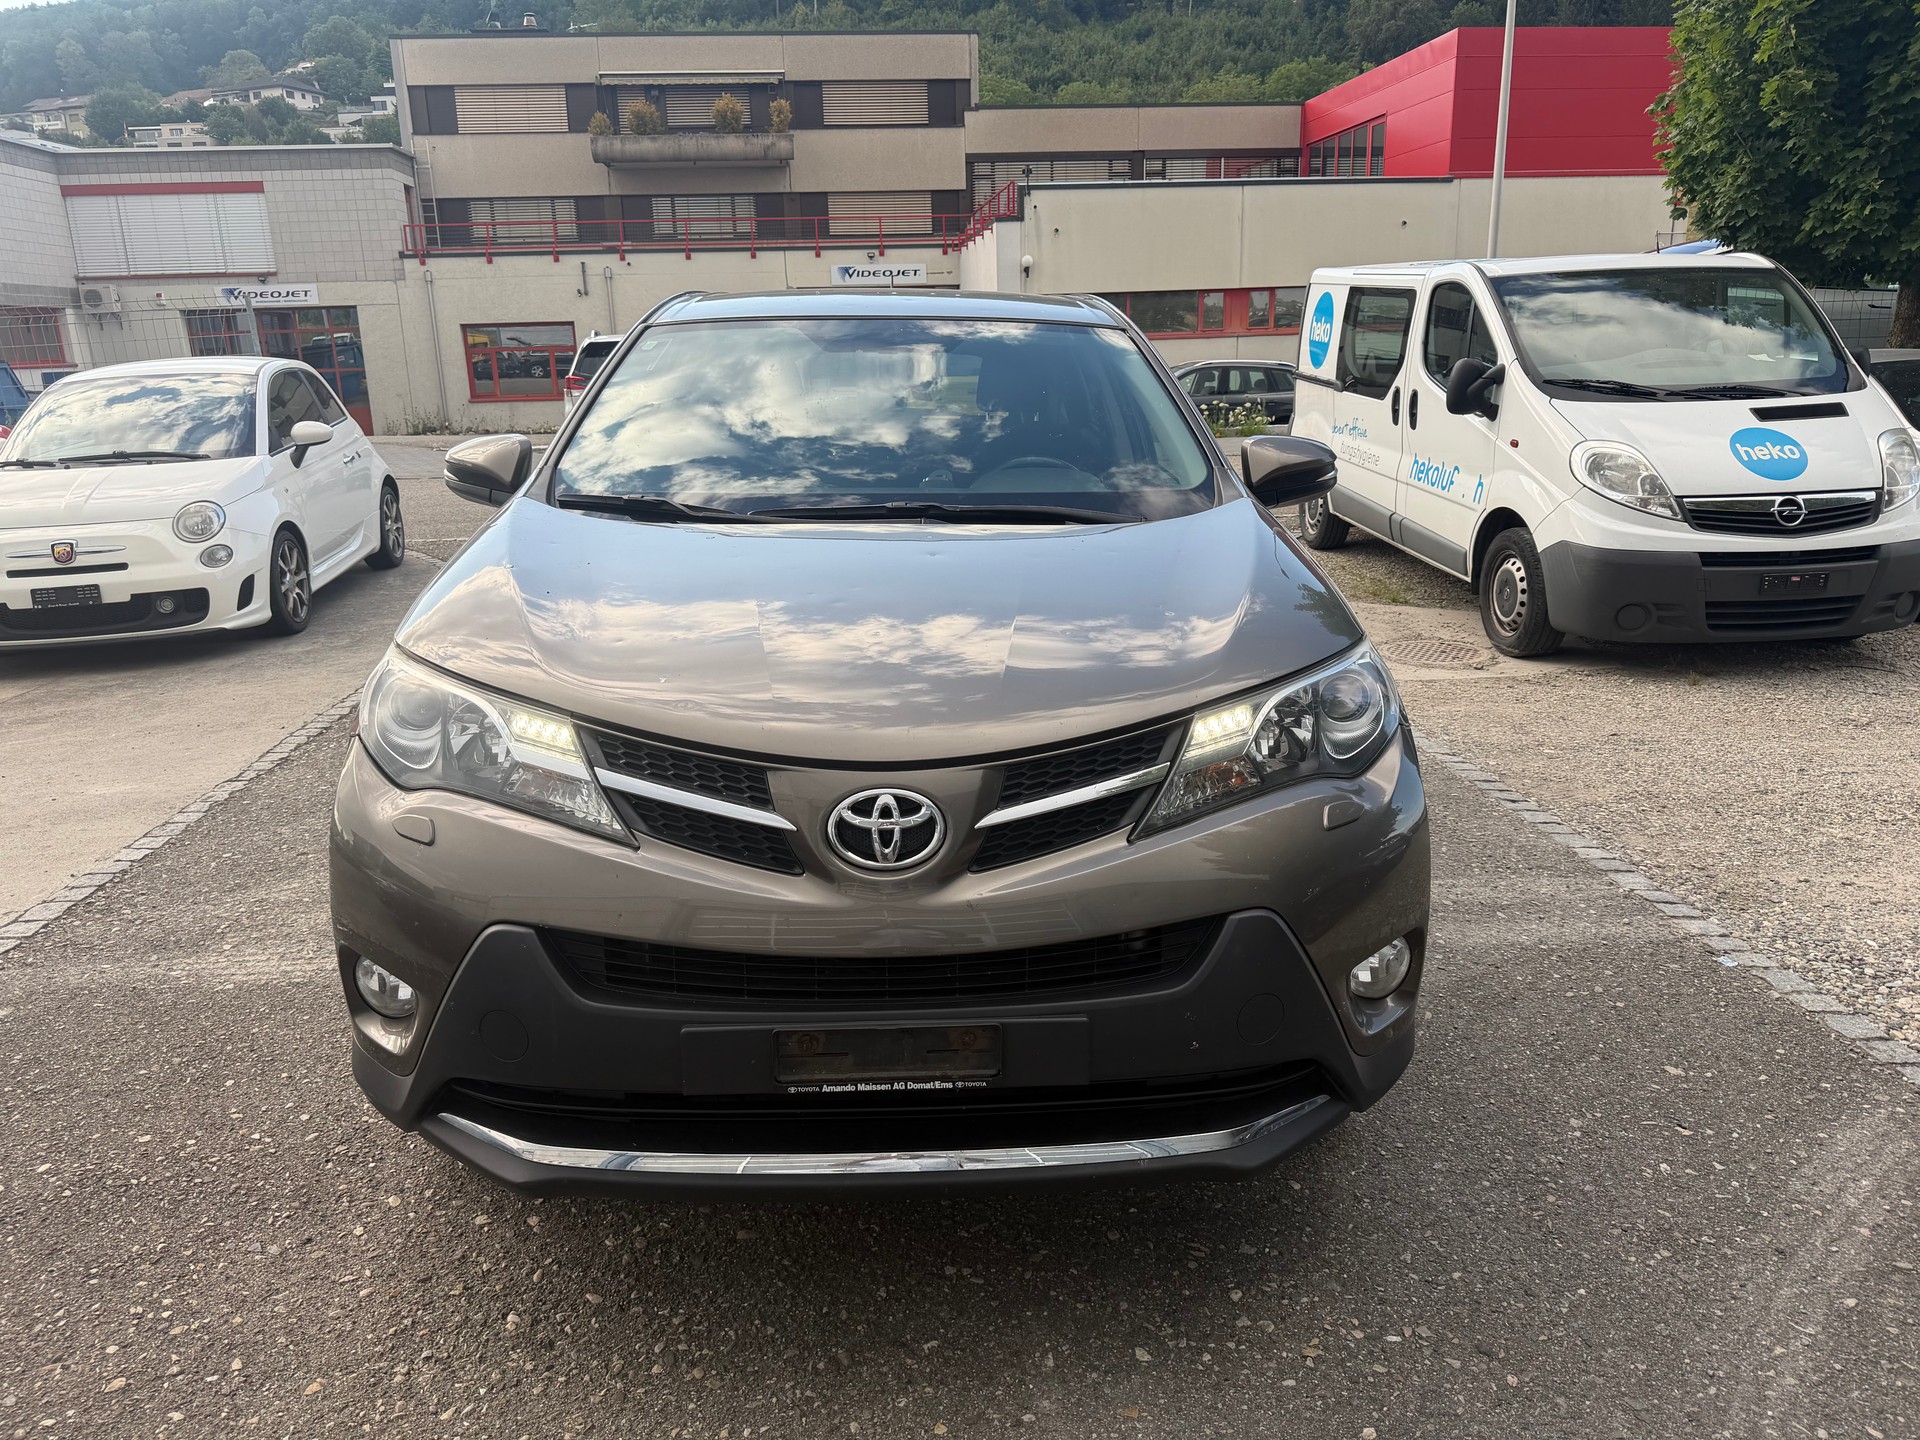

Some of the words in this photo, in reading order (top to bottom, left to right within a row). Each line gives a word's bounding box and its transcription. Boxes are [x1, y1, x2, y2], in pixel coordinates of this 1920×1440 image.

[844, 267, 920, 279] VIDEOJET
[231, 289, 312, 300] VIDEOJET
[1311, 316, 1331, 343] heko
[1735, 442, 1800, 461] heko
[822, 1083, 856, 1092] Amando
[857, 1082, 891, 1091] Maissen
[893, 1082, 905, 1090] AG
[907, 1081, 953, 1089] Domat/Ems
